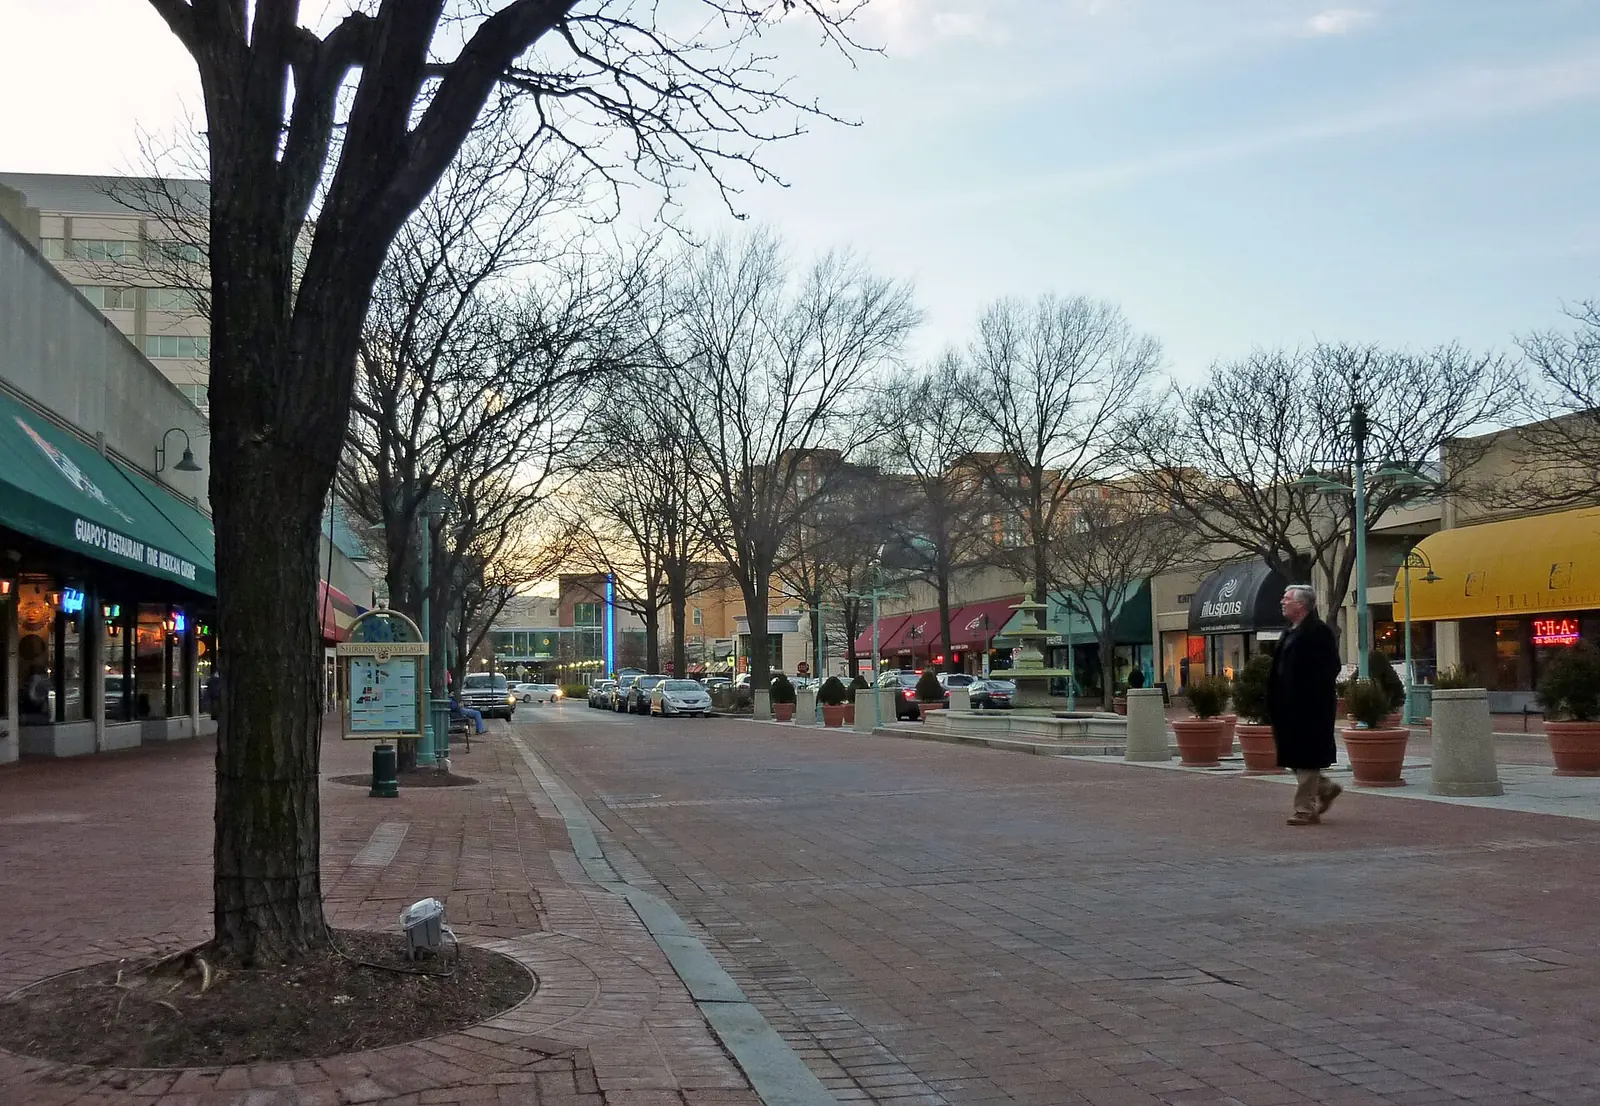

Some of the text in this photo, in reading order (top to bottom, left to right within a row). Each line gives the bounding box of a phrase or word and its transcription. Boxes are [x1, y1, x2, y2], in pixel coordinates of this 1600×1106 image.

[75, 518, 107, 548] GUAPO'S
[107, 531, 144, 562] RESTAURANT
[159, 551, 180, 575] MEXICAN
[1201, 600, 1242, 618] illusions
